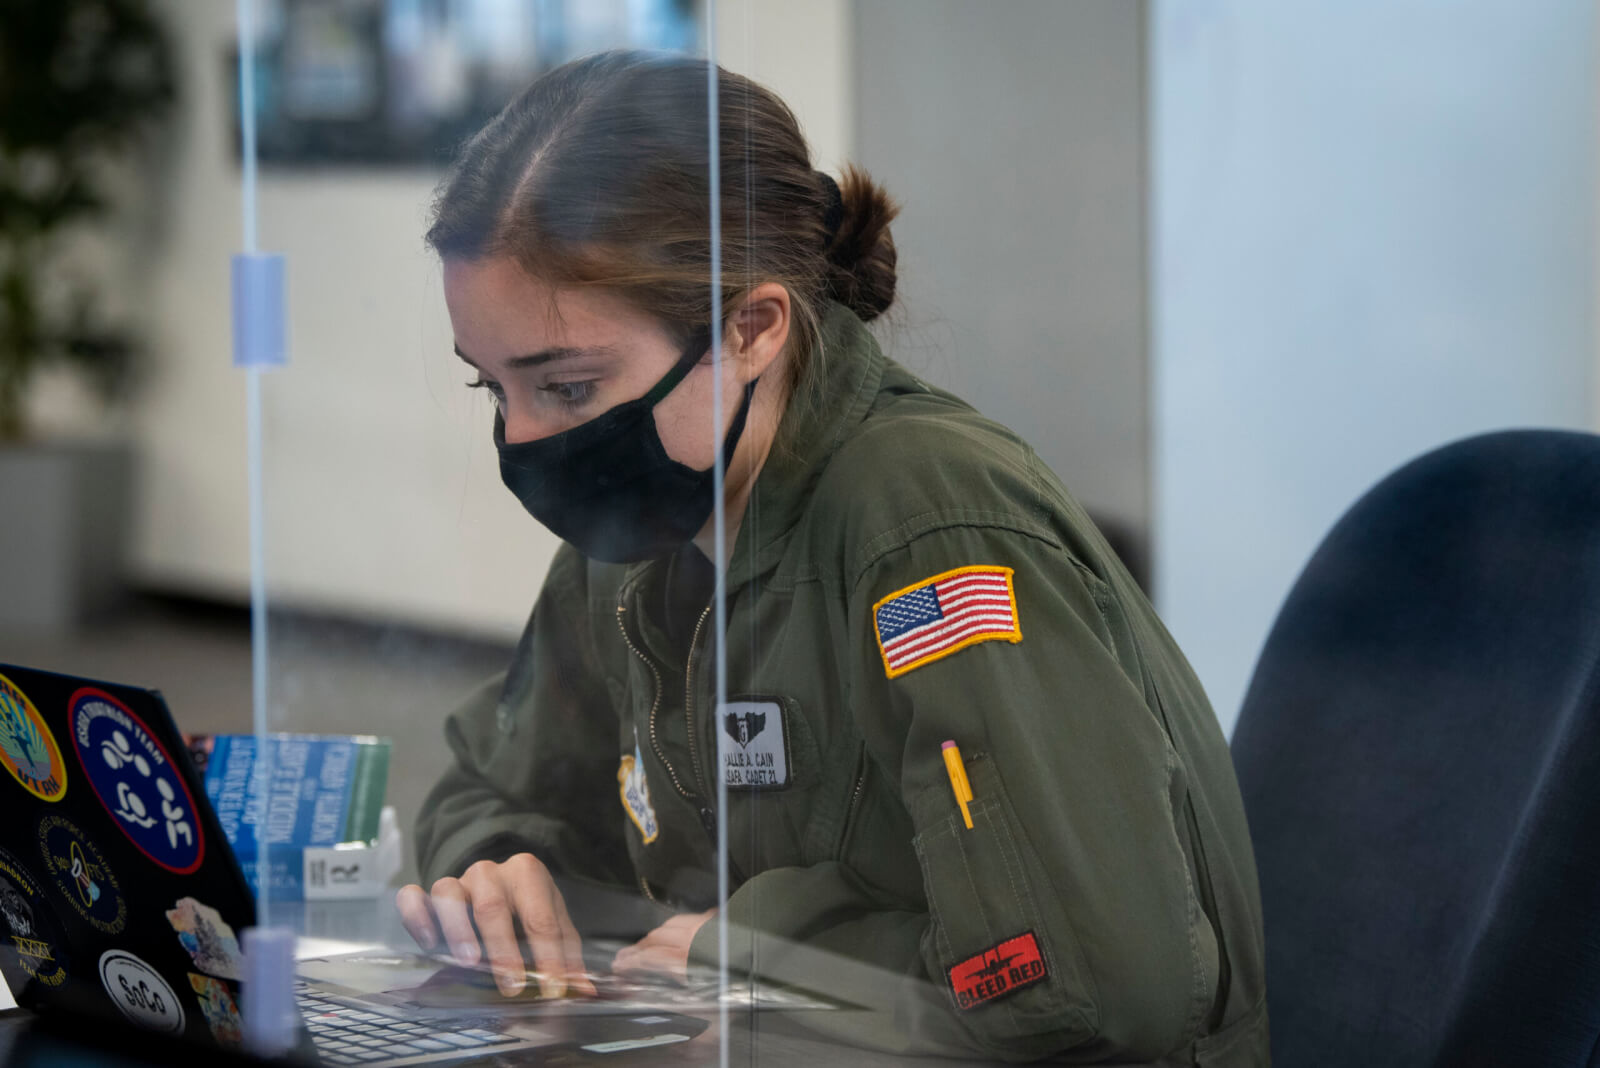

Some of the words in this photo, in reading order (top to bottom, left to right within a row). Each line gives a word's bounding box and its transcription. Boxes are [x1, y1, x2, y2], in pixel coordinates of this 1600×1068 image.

[134, 724, 165, 766] TEAM
[754, 752, 774, 767] CAIN
[17, 767, 61, 795] UTAH
[726, 769, 743, 784] SAFA
[745, 769, 768, 784] CADET
[768, 769, 778, 784] 21
[265, 781, 300, 843] MIDDLE
[56, 879, 89, 921] SOARING
[117, 973, 167, 1016] SoCo
[957, 976, 1007, 1006] BLEED
[1009, 960, 1041, 985] RED
